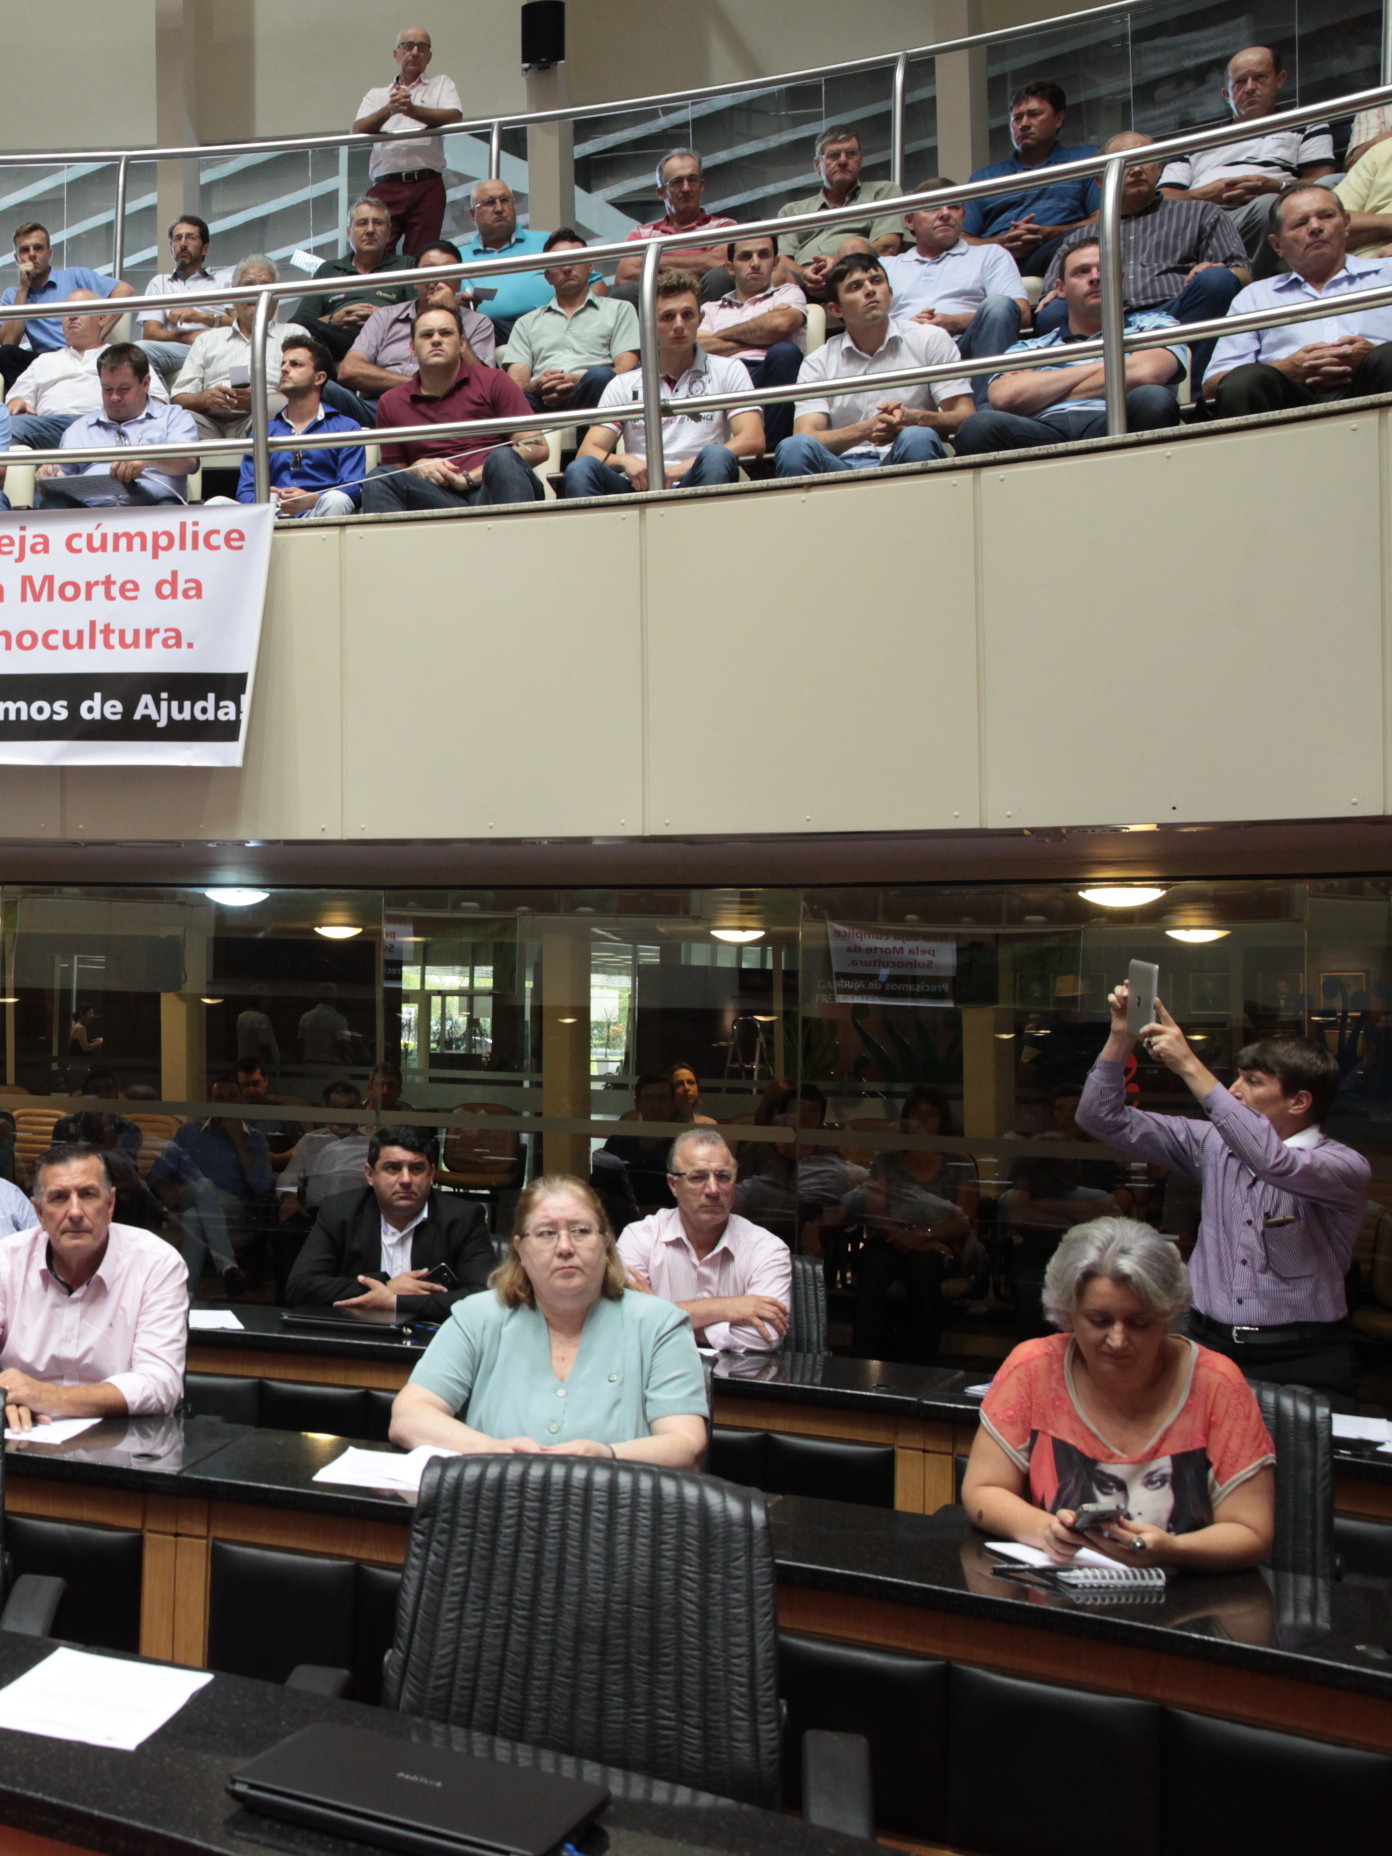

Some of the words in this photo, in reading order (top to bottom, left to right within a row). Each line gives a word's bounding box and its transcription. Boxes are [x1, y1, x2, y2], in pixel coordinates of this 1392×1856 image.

[64, 521, 247, 560] cúmplice
[19, 574, 141, 604] Morte
[154, 570, 204, 601] da
[78, 691, 124, 722] de
